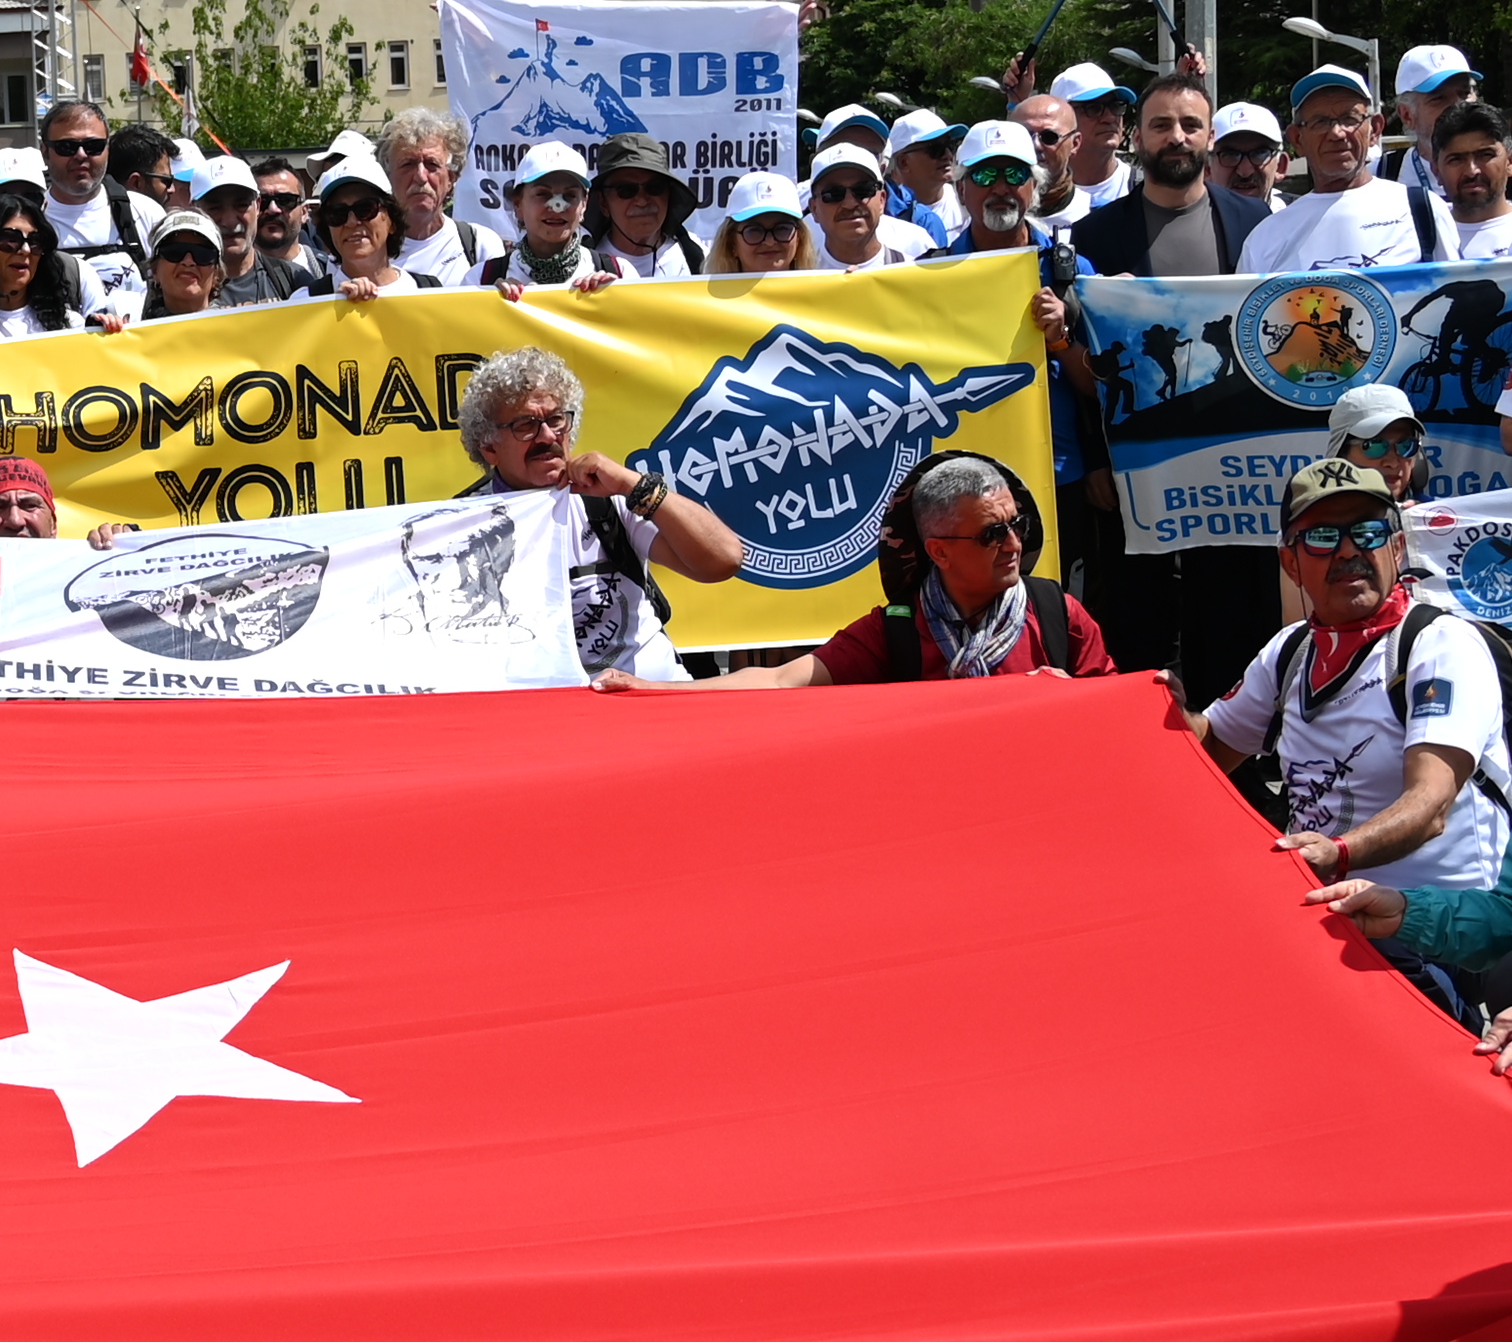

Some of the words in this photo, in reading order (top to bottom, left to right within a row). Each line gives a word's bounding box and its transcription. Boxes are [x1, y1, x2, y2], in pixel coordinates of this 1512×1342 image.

[620, 51, 784, 98] ADB
[734, 98, 782, 112] 2011
[476, 141, 530, 172] ANKA
[695, 131, 778, 168] BİRLİĞİ
[755, 474, 858, 534] YOLU
[1163, 483, 1282, 511] BİSİKL
[1428, 469, 1508, 497] OĞA
[1155, 511, 1280, 543] SPORL
[144, 547, 248, 565] FETHİYE
[99, 567, 172, 579] ZİRVE
[122, 667, 241, 692] ZİRVE
[254, 678, 437, 697] DAĞCILIK
